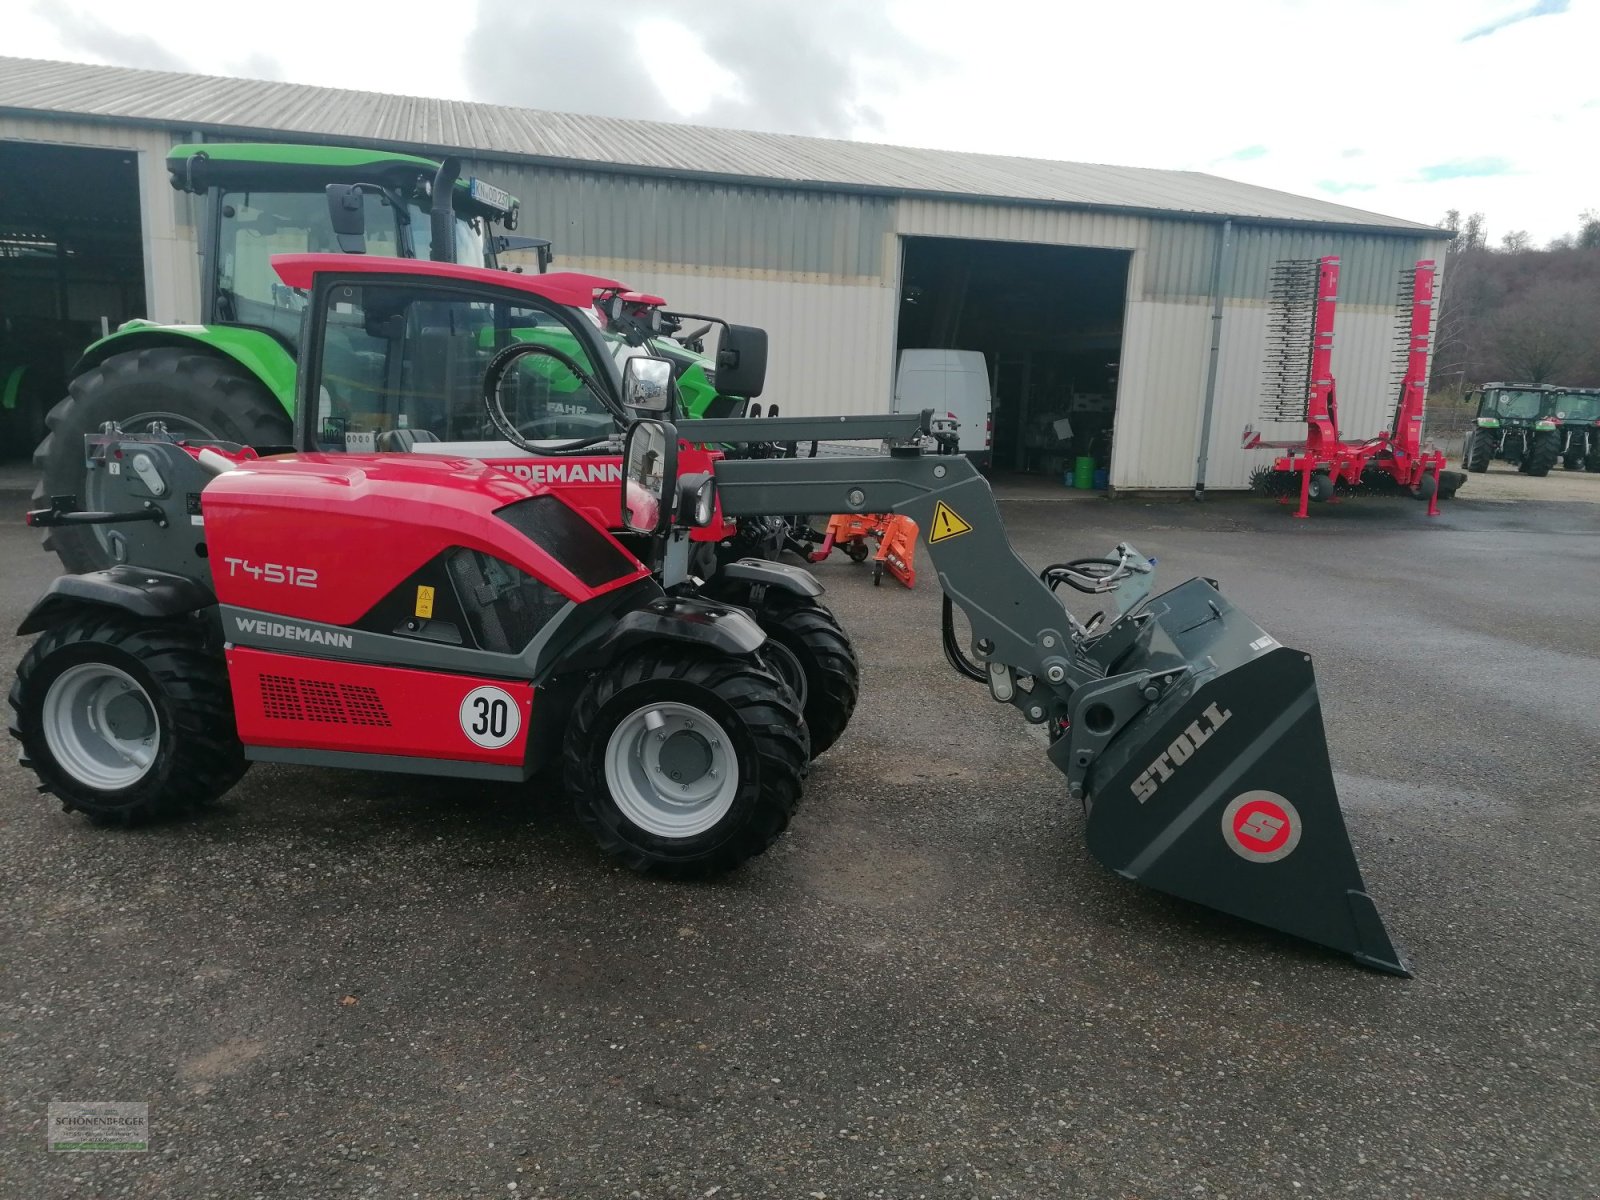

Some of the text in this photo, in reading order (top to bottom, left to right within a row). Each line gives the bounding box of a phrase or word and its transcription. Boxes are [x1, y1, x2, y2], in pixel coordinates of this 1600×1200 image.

[547, 402, 587, 416] FAHR
[492, 464, 622, 482] DEMANN
[225, 557, 318, 588] T4512
[236, 617, 353, 648] WEIDEMANN
[473, 697, 507, 738] 30
[1130, 701, 1233, 804] STOLL
